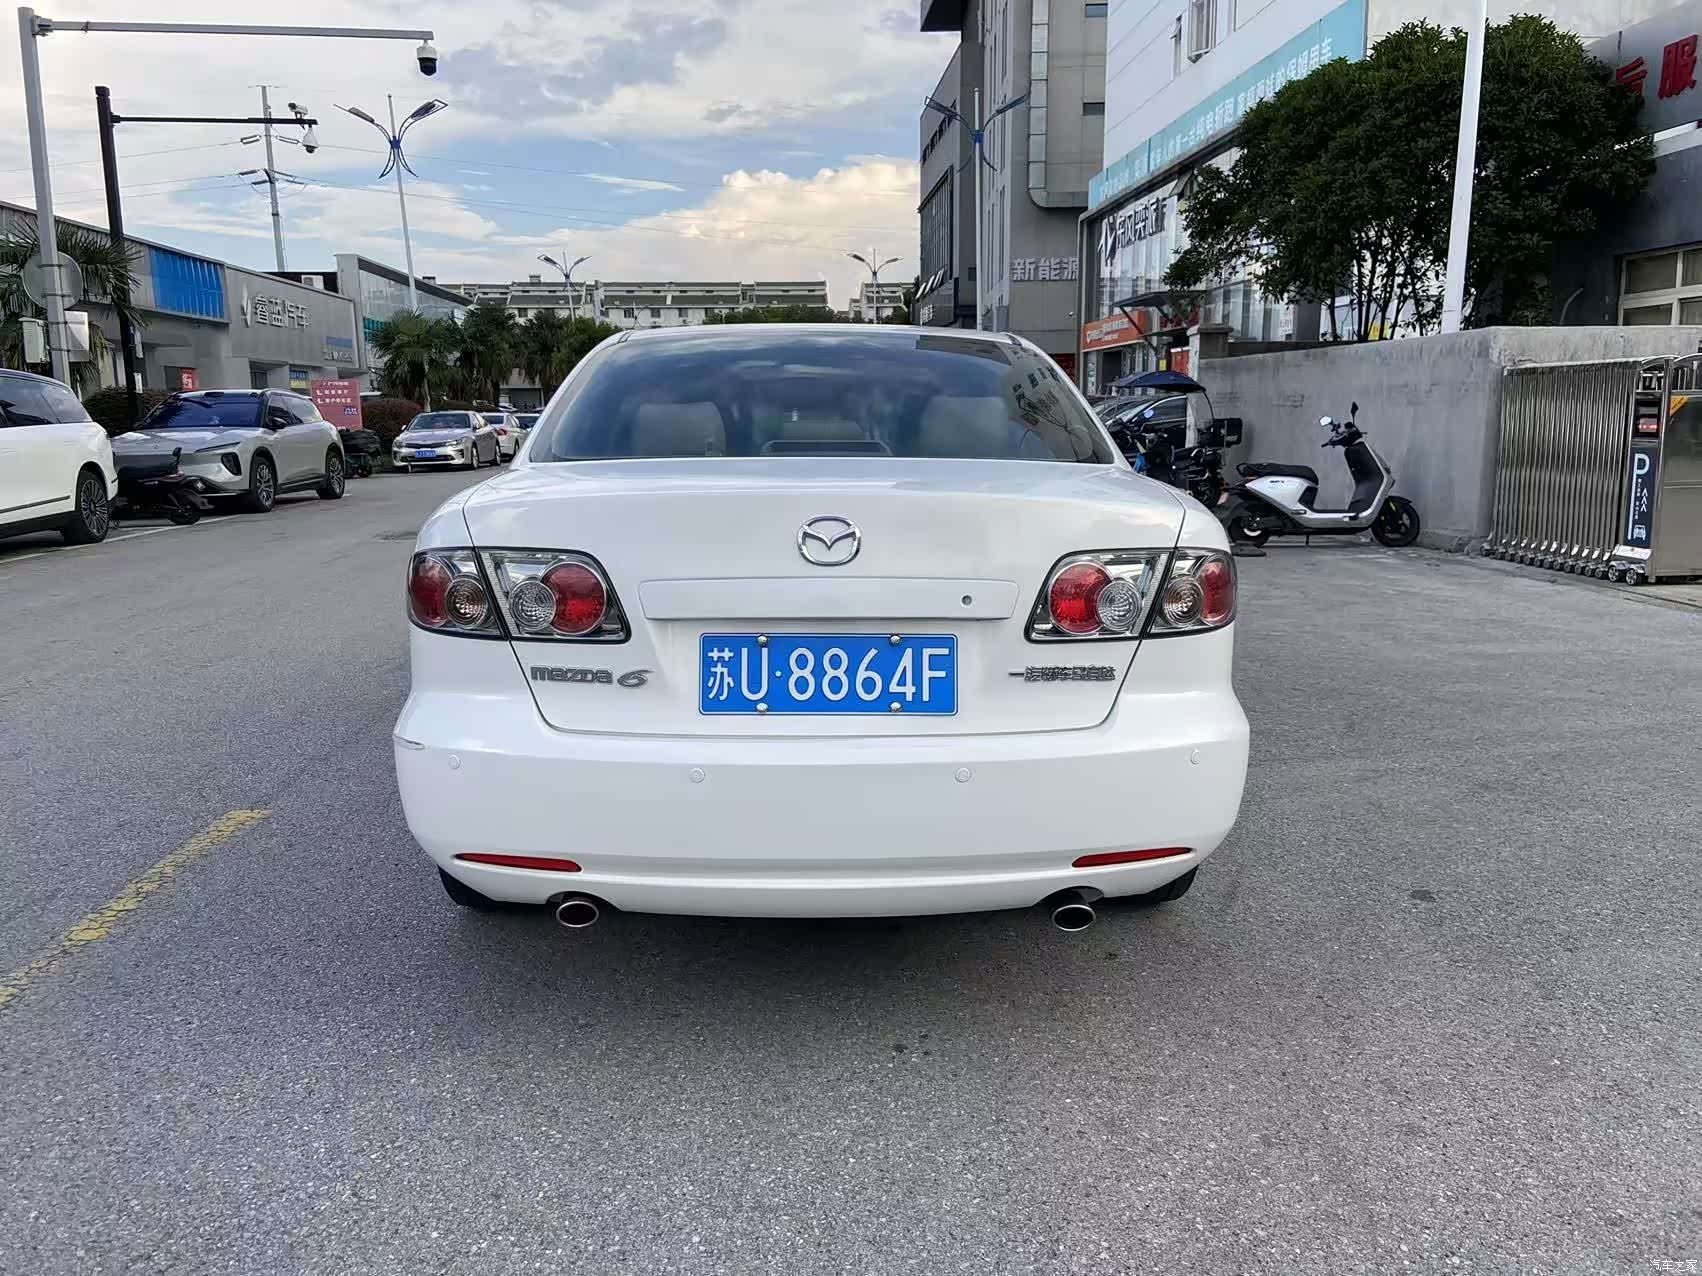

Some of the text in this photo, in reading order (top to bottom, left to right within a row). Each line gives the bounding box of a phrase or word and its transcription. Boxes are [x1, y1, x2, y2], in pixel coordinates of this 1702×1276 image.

[1013, 256, 1078, 281] 新能源
[617, 669, 655, 688] 6
[707, 647, 950, 702] 苏U·8864F
